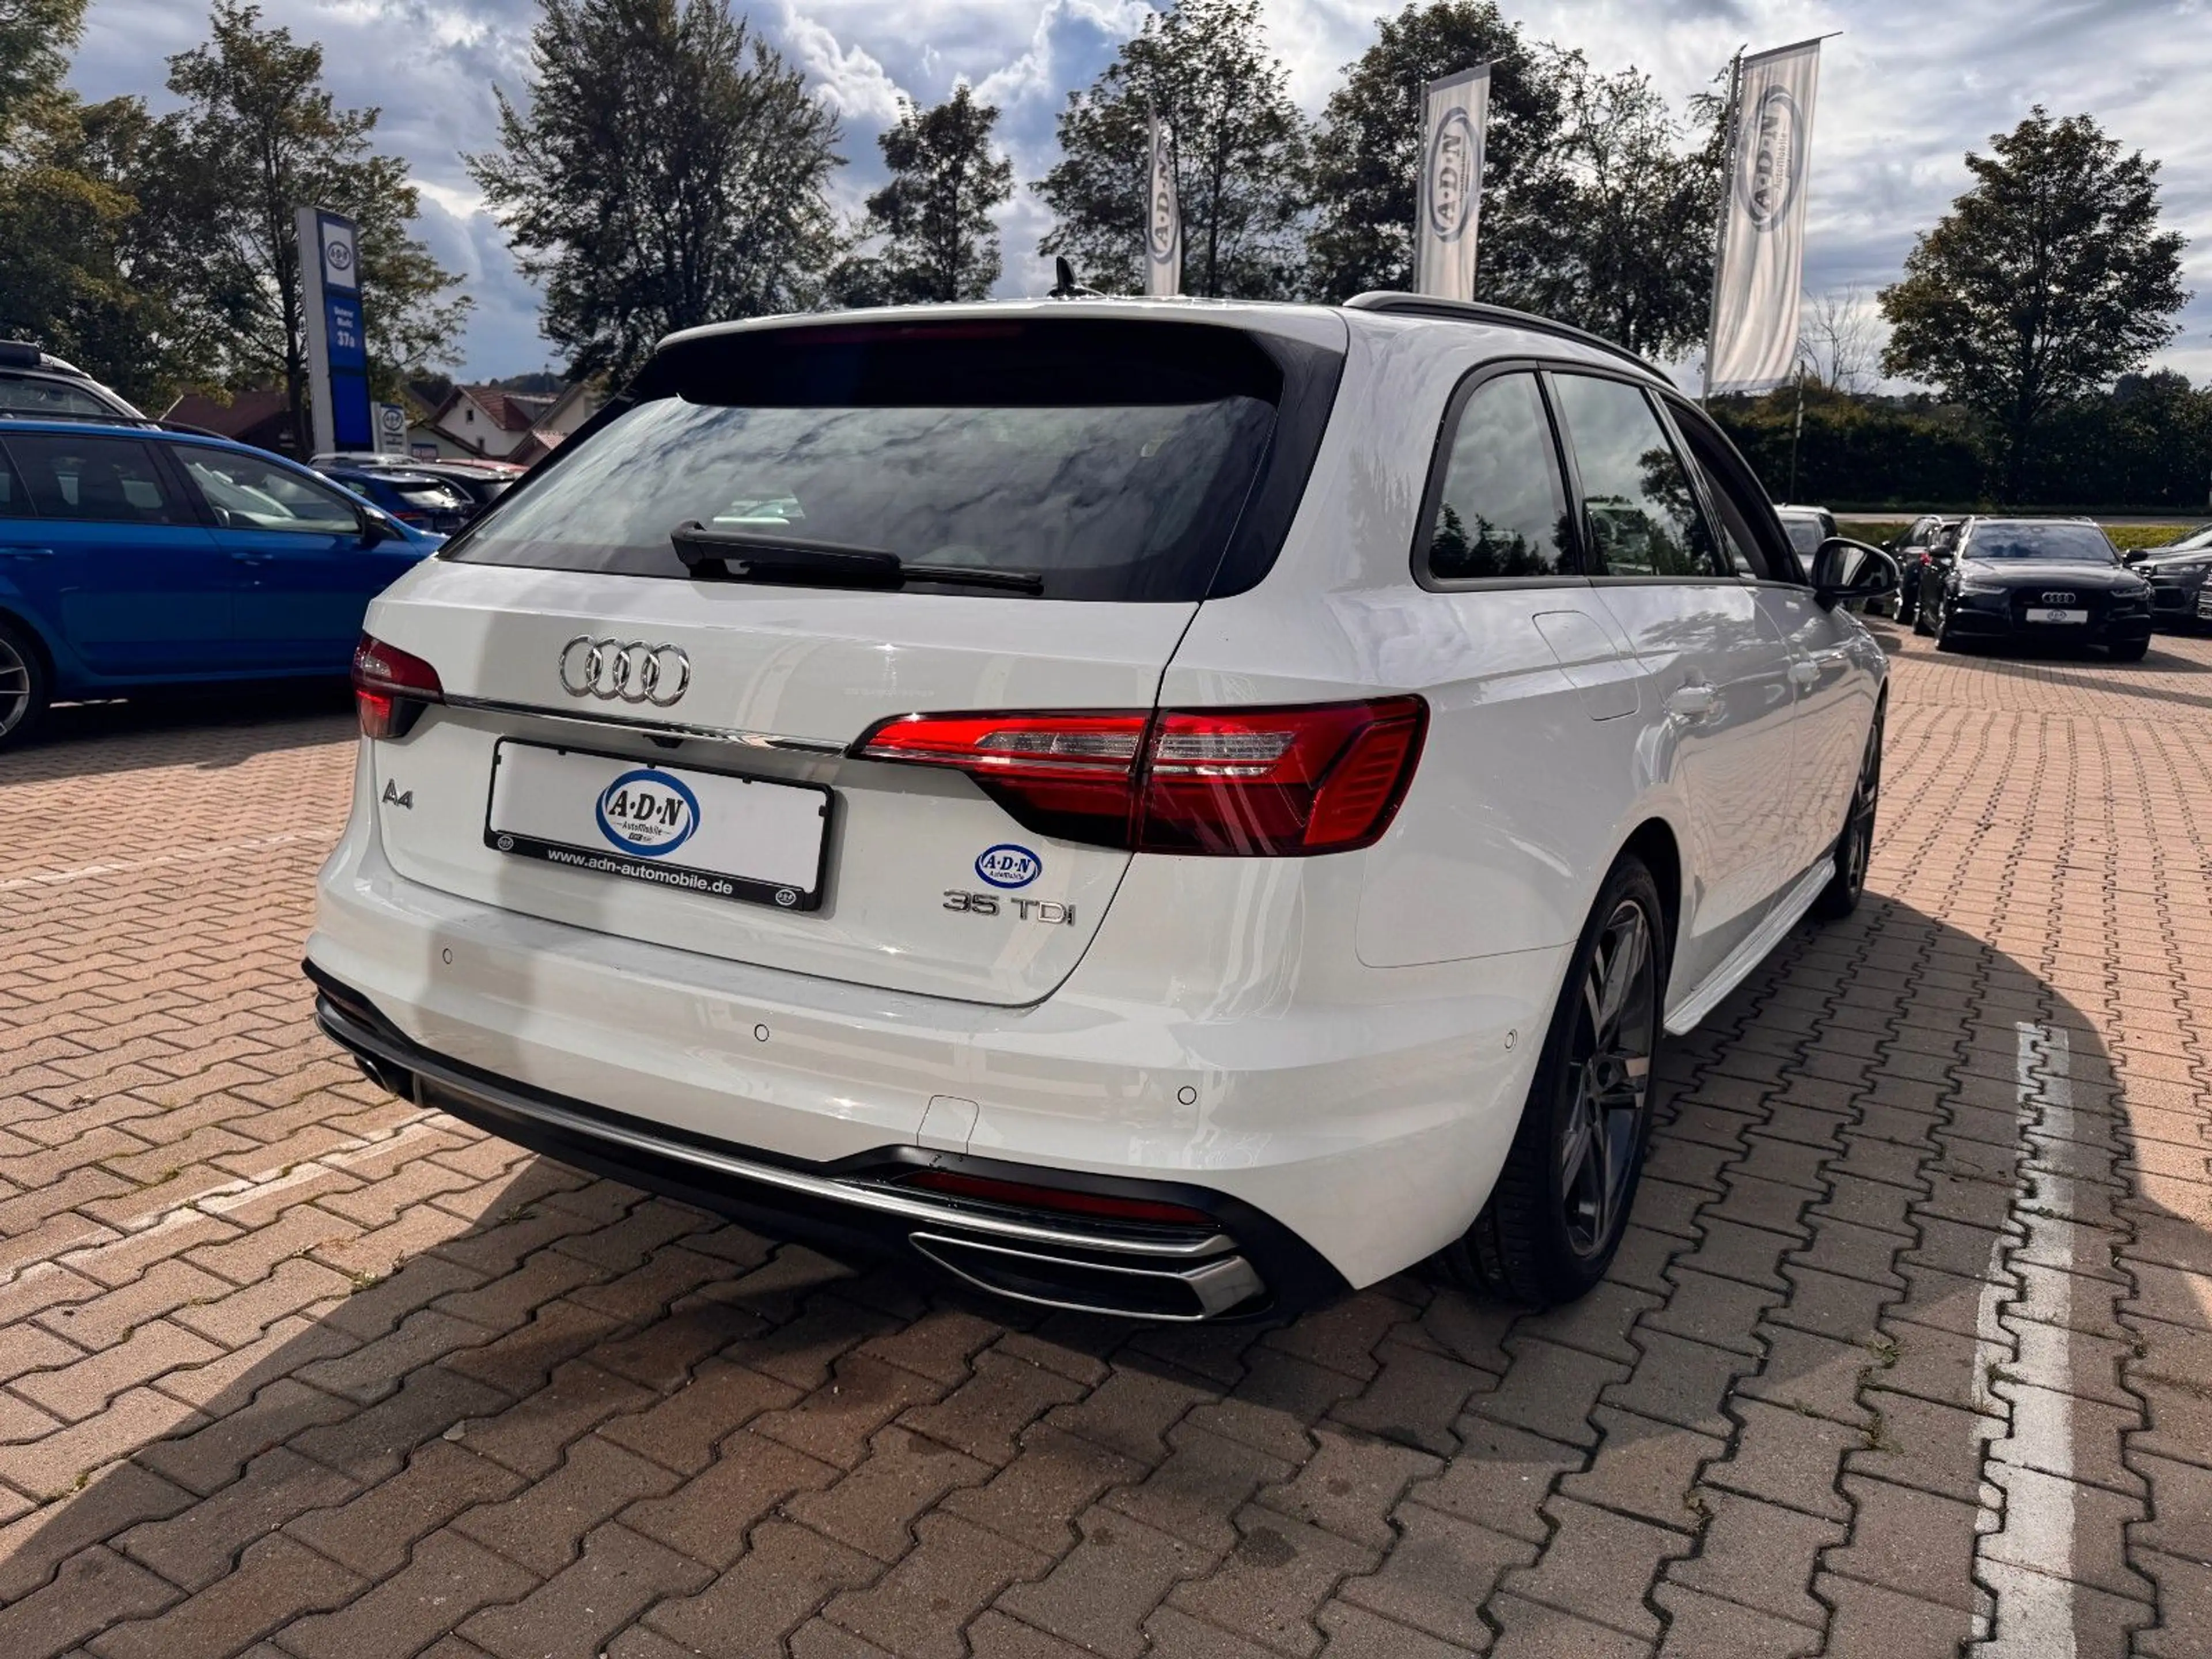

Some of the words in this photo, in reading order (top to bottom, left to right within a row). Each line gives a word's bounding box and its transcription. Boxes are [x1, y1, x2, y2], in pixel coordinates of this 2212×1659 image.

[382, 778, 414, 809] A4
[547, 849, 733, 895] www.adn-automobile.de
[942, 888, 1000, 916] 35
[1010, 897, 1077, 926] TDI
